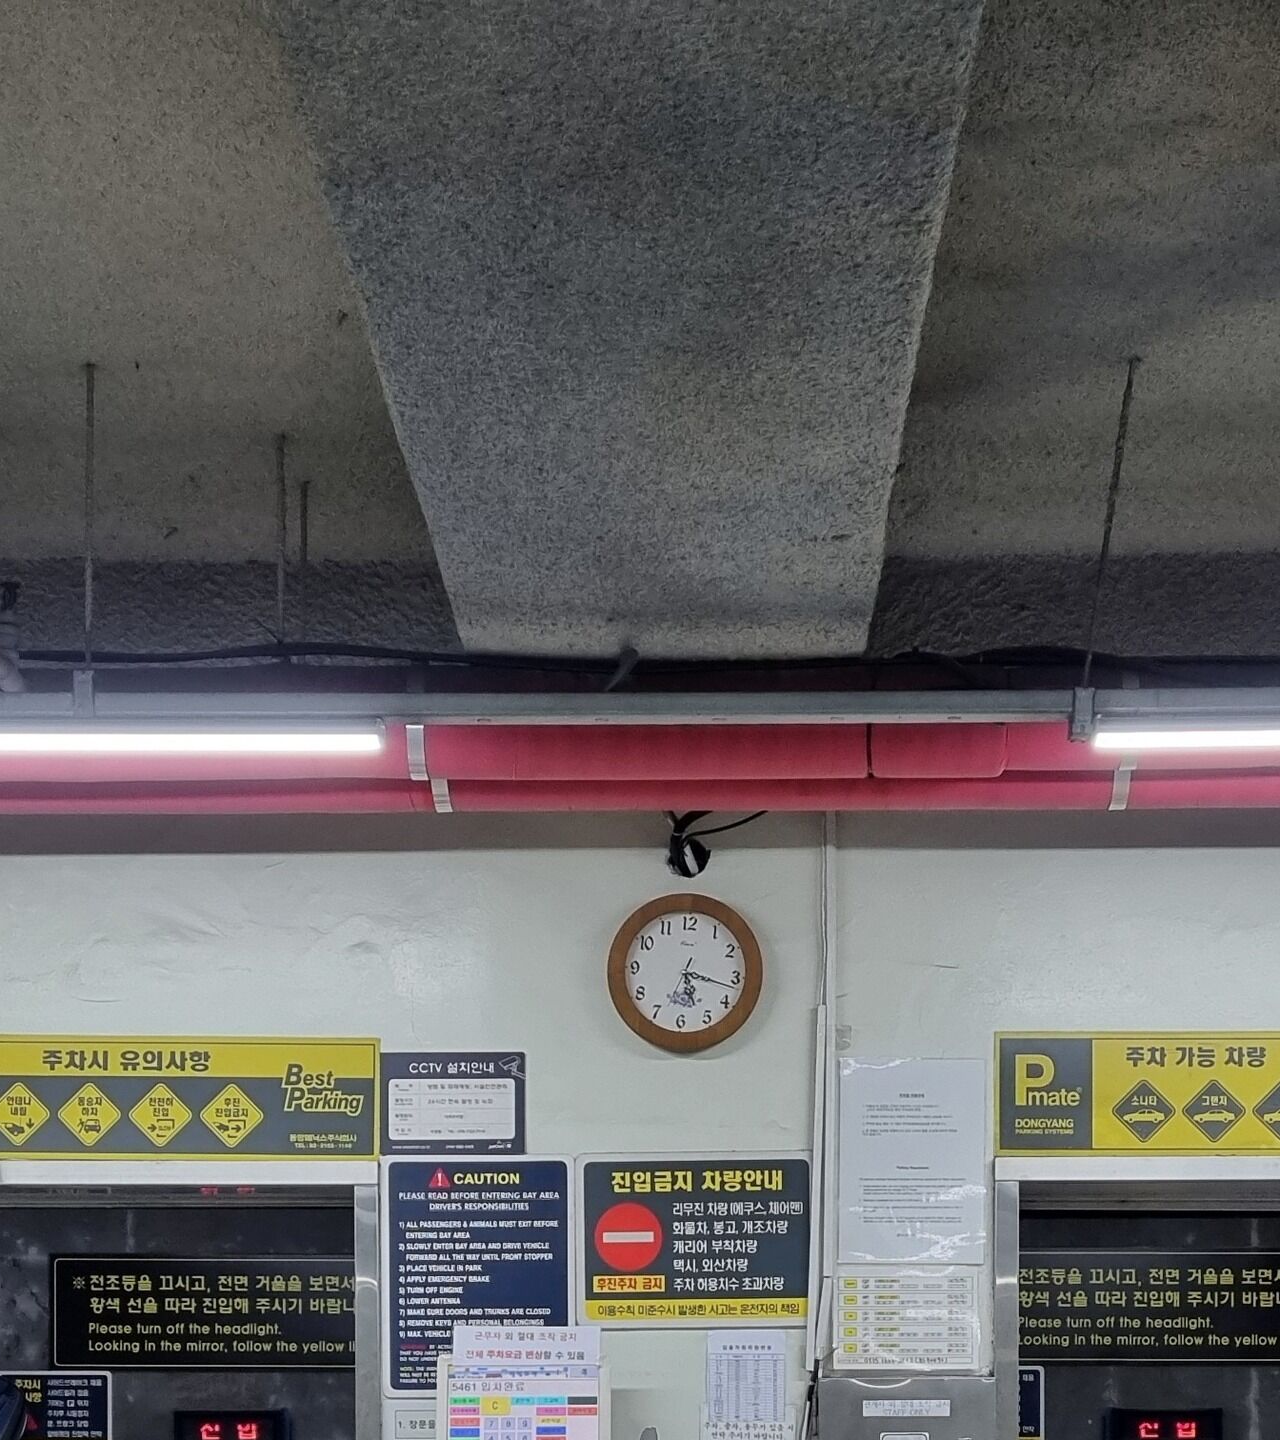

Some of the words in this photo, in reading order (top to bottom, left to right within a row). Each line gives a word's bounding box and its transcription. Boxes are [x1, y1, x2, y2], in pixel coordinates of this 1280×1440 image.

[660, 920, 672, 935] 11
[683, 916, 698, 931] 12
[712, 925, 718, 939] 1
[640, 935, 654, 950] 10
[725, 944, 735, 958] 2
[630, 960, 640, 975] 9
[730, 970, 741, 985] 3
[635, 986, 645, 1000] 8
[720, 994, 729, 1009] 4
[652, 1005, 662, 1019] 7
[702, 1010, 712, 1024] 5
[676, 1014, 686, 1028] 6
[42, 1050, 109, 1071] 주차시
[120, 1050, 210, 1072] 유의사항
[1125, 1047, 1166, 1068] 주차
[1175, 1047, 1216, 1068] 가능
[1224, 1047, 1267, 1068] 차량
[409, 1063, 442, 1073] CCTV
[447, 1062, 495, 1073] 설치안내
[284, 1063, 334, 1087] Best
[1015, 1054, 1080, 1106] Pmate
[7, 1097, 31, 1106] 안테나
[224, 1098, 240, 1107] 후진
[287, 1088, 361, 1114] Parking
[153, 1108, 169, 1117] 진입
[215, 1108, 248, 1118] 진입금지
[1015, 1119, 1073, 1128] DONGYANG
[453, 1173, 520, 1185] CAUTION
[611, 1171, 693, 1193] 진입금지
[702, 1170, 782, 1191] 차량안내
[399, 1192, 426, 1200] PLEASE
[428, 1192, 448, 1200] READ
[451, 1192, 478, 1200] BEFORE
[482, 1192, 520, 1200] ENTERING
[523, 1192, 537, 1200] BAY
[539, 1191, 560, 1199] AREA
[429, 1203, 462, 1211] DRIVER'S
[672, 1202, 704, 1216] 리무진
[707, 1202, 728, 1216] 차량
[672, 1221, 710, 1235] 화물차,
[713, 1221, 739, 1235] 봉고,
[742, 1221, 788, 1235] 개조차량
[672, 1240, 707, 1254] 캐리어
[711, 1239, 758, 1253] 부착차량
[673, 1259, 699, 1273] 택시,
[702, 1258, 748, 1272] 외산차량
[597, 1278, 637, 1290] 후진주차
[642, 1277, 662, 1290] 금지
[674, 1278, 694, 1291] 주차
[742, 1277, 784, 1290] 초과차량
[1019, 1268, 1082, 1286] 전조등을
[1090, 1268, 1142, 1286] 끄시고,
[1149, 1268, 1179, 1285] 전면
[1187, 1268, 1234, 1285] 거울을
[90, 1275, 152, 1292] 전조등을
[159, 1275, 211, 1294] 끄시고,
[217, 1275, 248, 1292] 전면
[256, 1275, 302, 1292] 거울을
[309, 1275, 355, 1292] 보면서
[90, 1298, 120, 1314] 황색
[127, 1298, 158, 1314] 선을
[165, 1298, 196, 1314] 따라
[202, 1298, 249, 1314] 진입해
[256, 1298, 302, 1314] 주시기
[1019, 1291, 1050, 1308] 황색
[1056, 1291, 1088, 1308] 선을
[1095, 1291, 1127, 1308] 따라
[1133, 1291, 1180, 1308] 진입해
[1187, 1291, 1235, 1308] 주시기
[598, 1305, 635, 1316] 이용수칙
[638, 1304, 676, 1316] 미준수시
[678, 1304, 706, 1316] 발생한
[710, 1304, 738, 1315] 사고는
[740, 1304, 778, 1315] 운전자의
[780, 1303, 799, 1315] 책임
[89, 1322, 133, 1335] Please
[136, 1324, 161, 1335] turn
[166, 1322, 184, 1335] off
[189, 1322, 210, 1335] the
[214, 1322, 281, 1338] headlight.
[1019, 1316, 1061, 1328] Please
[1067, 1317, 1091, 1328] turn
[1096, 1316, 1114, 1328] off
[1119, 1316, 1141, 1328] the
[1145, 1316, 1213, 1331] headlight.
[89, 1340, 140, 1354] Looking
[144, 1340, 156, 1352] in
[161, 1340, 182, 1352] the
[186, 1340, 227, 1354] mirror,
[233, 1340, 272, 1352] follow
[276, 1340, 297, 1352] the
[302, 1340, 344, 1355] yellow
[1074, 1334, 1086, 1345] in
[1090, 1334, 1112, 1346] the
[1116, 1334, 1159, 1347] mirror,
[1163, 1333, 1203, 1346] follow
[1208, 1333, 1230, 1346] the
[1234, 1334, 1277, 1348] yellow
[452, 1382, 477, 1391] 5461
[491, 1401, 499, 1410] C
